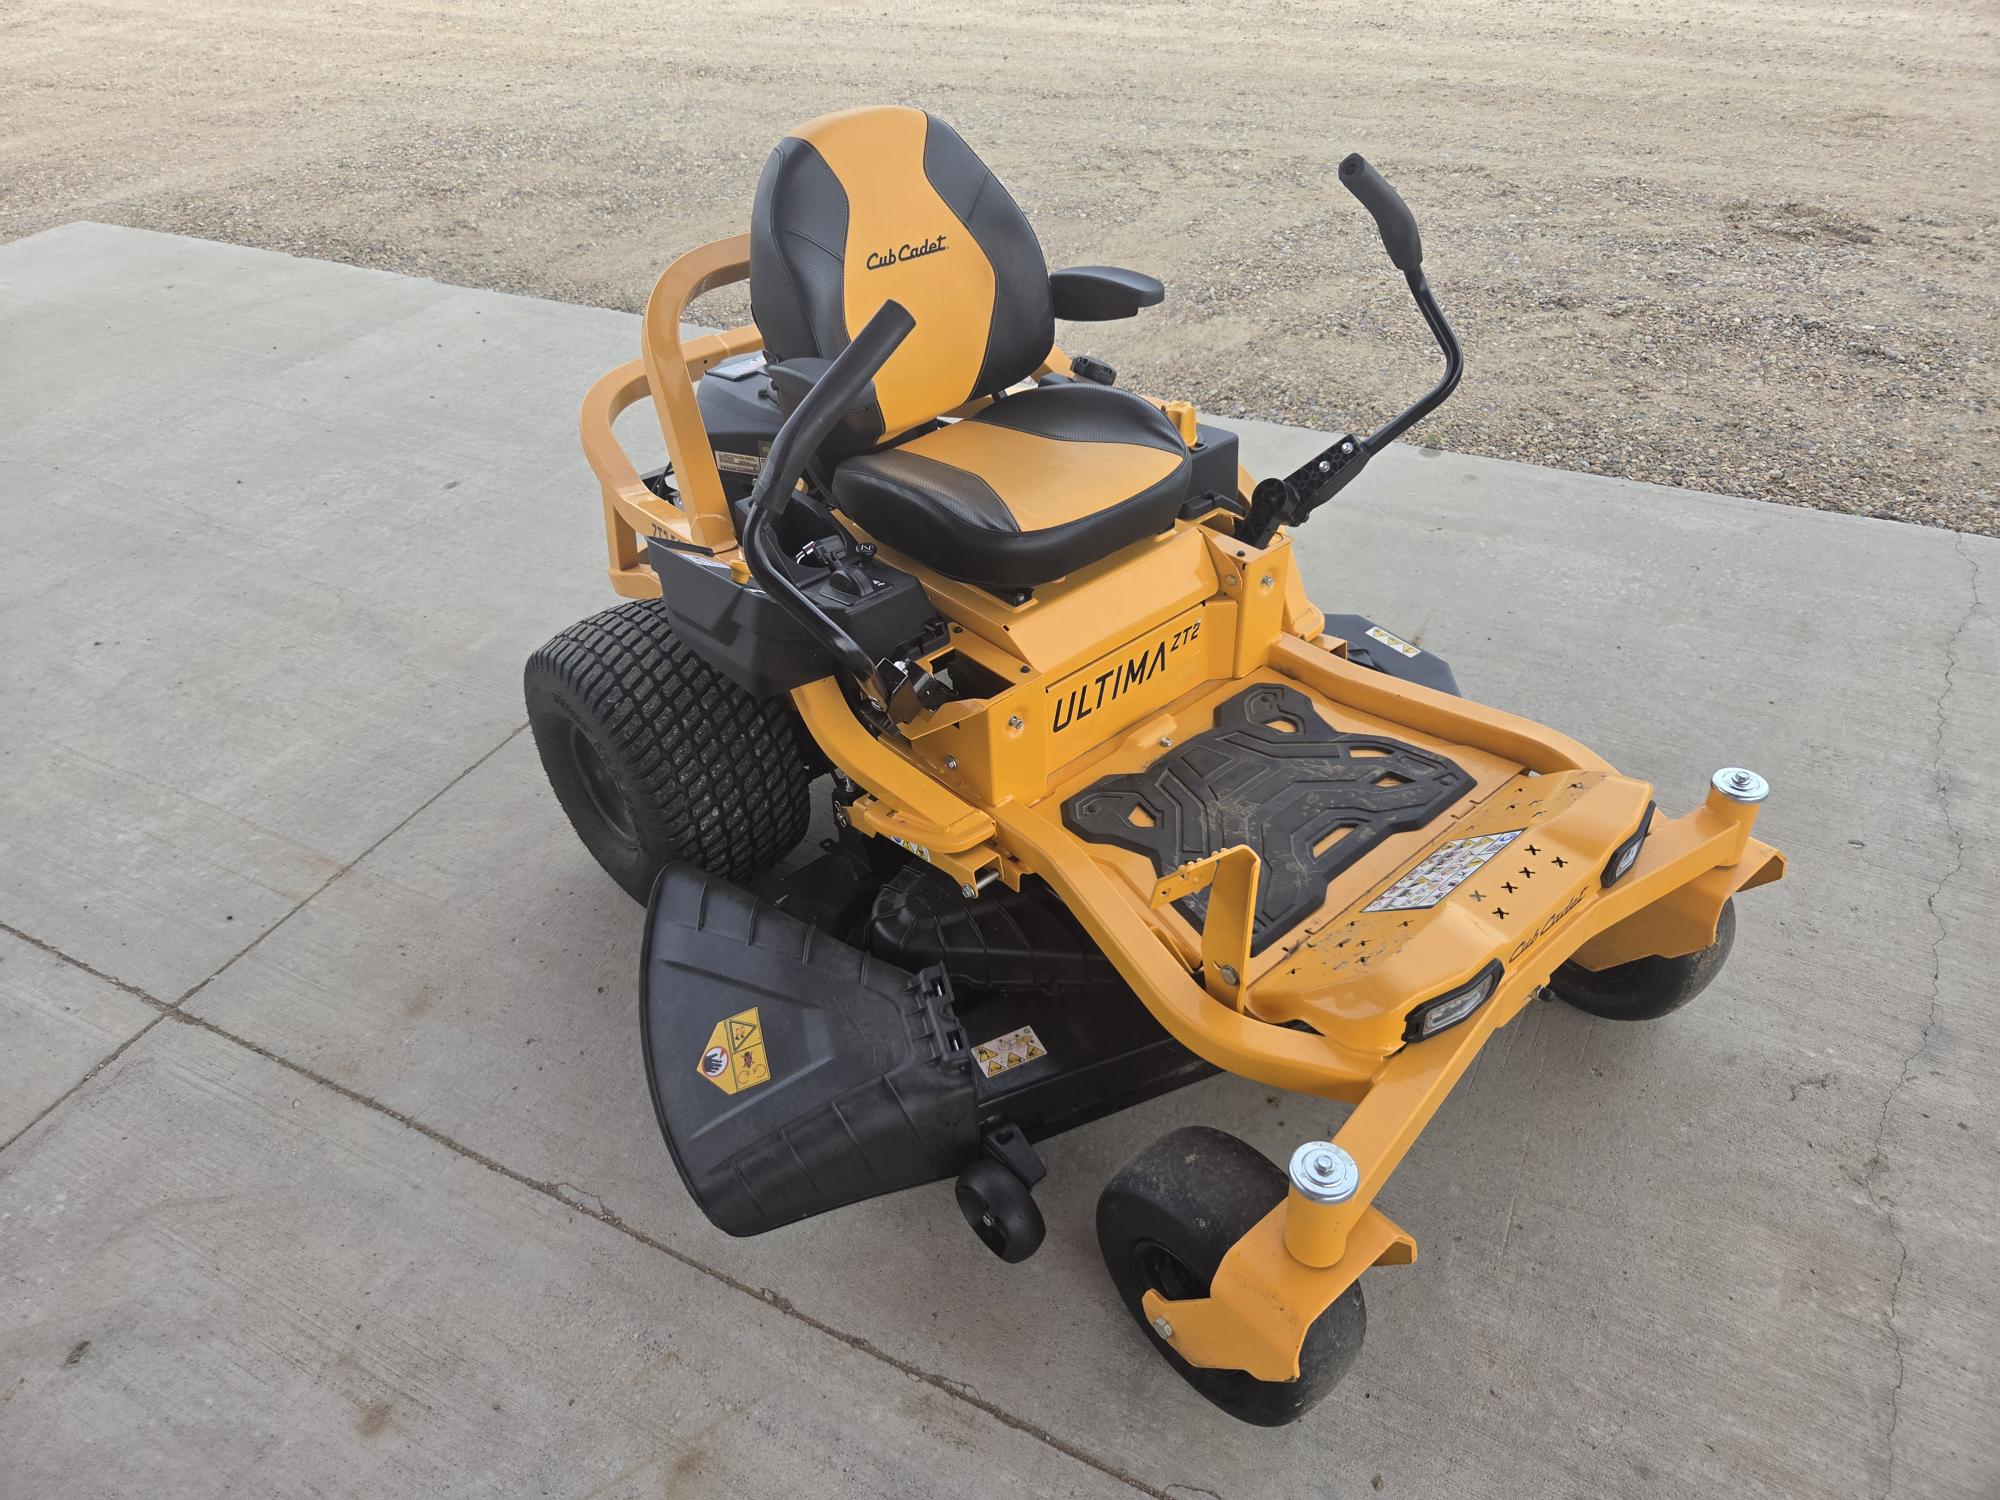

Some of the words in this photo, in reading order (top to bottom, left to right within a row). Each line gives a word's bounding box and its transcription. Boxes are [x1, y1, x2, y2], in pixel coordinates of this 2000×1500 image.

[866, 248, 896, 271] Cub
[898, 235, 946, 262] Cadet
[1053, 641, 1165, 733] ULTIMA
[1170, 622, 1201, 652] ZT2
[1509, 928, 1540, 964] Cub
[1539, 886, 1588, 936] Cadet
